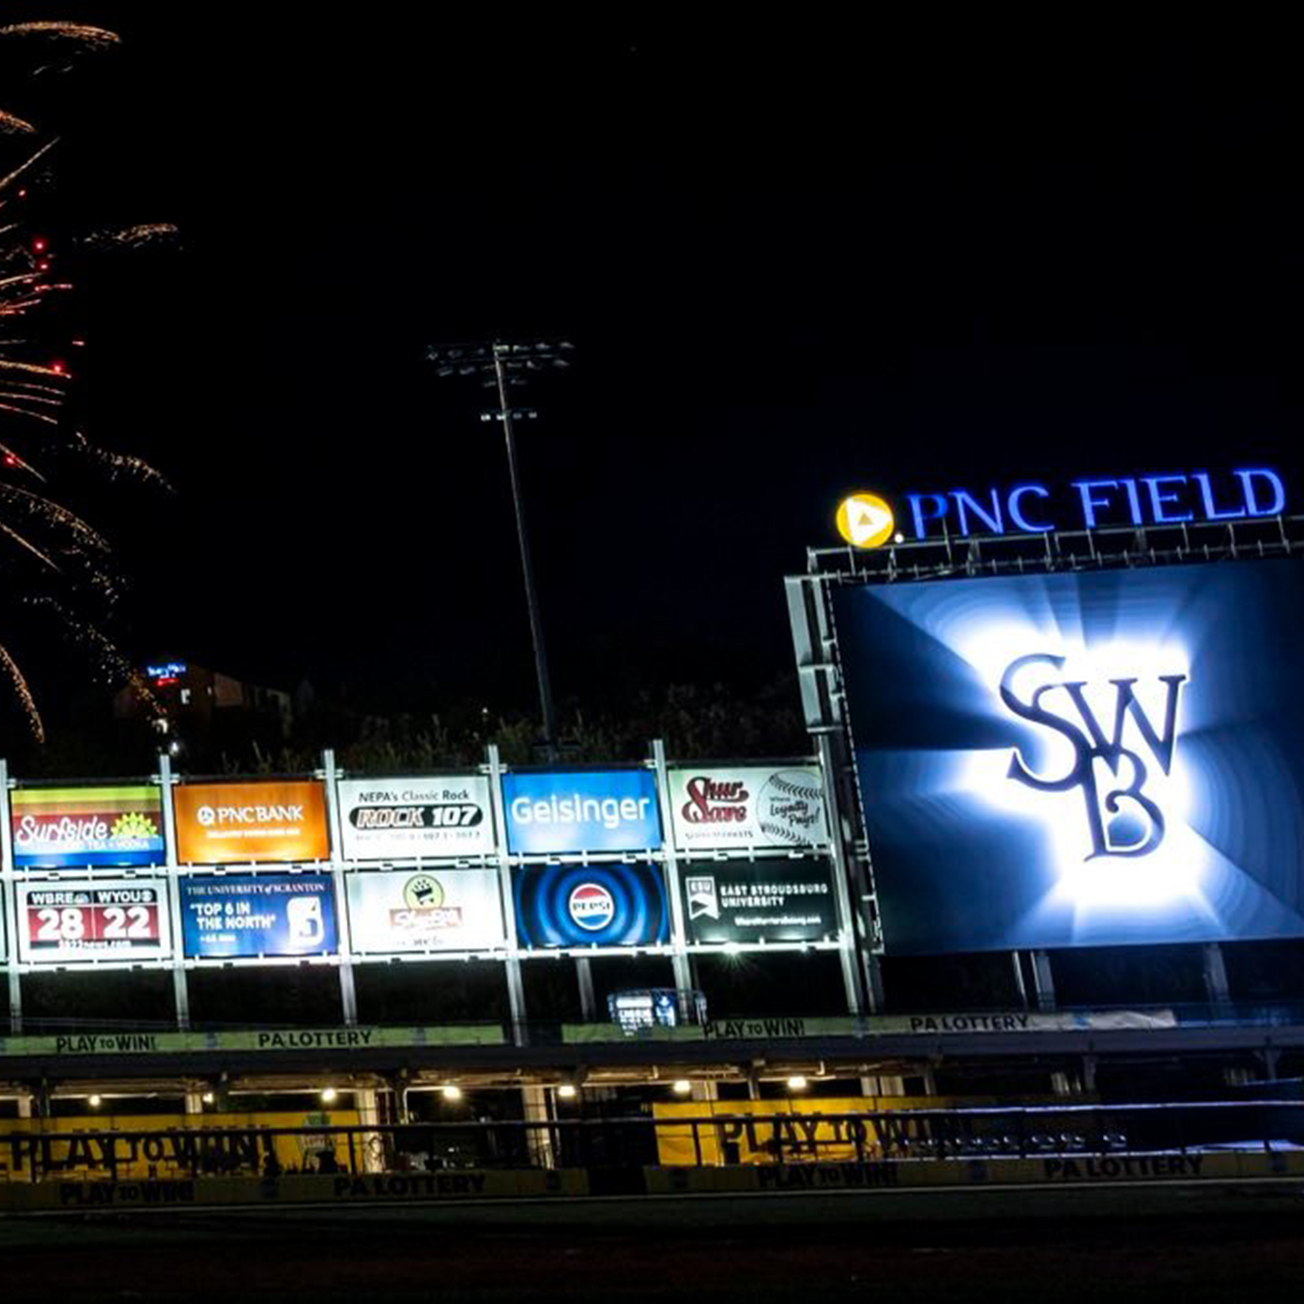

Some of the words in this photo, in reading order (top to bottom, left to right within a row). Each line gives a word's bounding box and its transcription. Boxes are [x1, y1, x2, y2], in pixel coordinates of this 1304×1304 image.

[909, 484, 1055, 540] PNC
[1071, 468, 1286, 529] FIELD
[402, 790, 439, 801] Classic
[442, 789, 469, 800] Rock
[357, 808, 424, 827] ROCK
[433, 807, 477, 825] 107
[511, 794, 649, 828] Geisinger
[16, 815, 107, 845] Surfside
[98, 891, 140, 902] WYOU
[208, 885, 263, 894] UNIVERSITY
[273, 883, 325, 893] SCRANTON
[720, 885, 747, 896] EAST
[751, 883, 828, 895] STROUDSBURG
[32, 893, 73, 904] WBRE
[572, 901, 610, 911] PEPSI
[721, 897, 785, 907] UNIVERSITY
[225, 903, 234, 915] 6
[237, 902, 250, 914] IN
[37, 908, 84, 940] 28
[103, 906, 151, 938] 22
[196, 917, 223, 930] THE
[703, 1020, 746, 1039] PLAY
[910, 1016, 939, 1032] PA
[941, 1013, 1029, 1031] LOTTERY
[56, 1036, 98, 1053] PLAY
[258, 1032, 284, 1049] PA
[286, 1030, 371, 1047] LOTTERY
[758, 1163, 818, 1187] PLAY
[1045, 1159, 1079, 1177] PA
[1087, 1155, 1202, 1177] LOTTERY
[61, 1184, 116, 1204] PLAY
[334, 1178, 364, 1195] PA
[374, 1174, 485, 1195] LOTTERY
